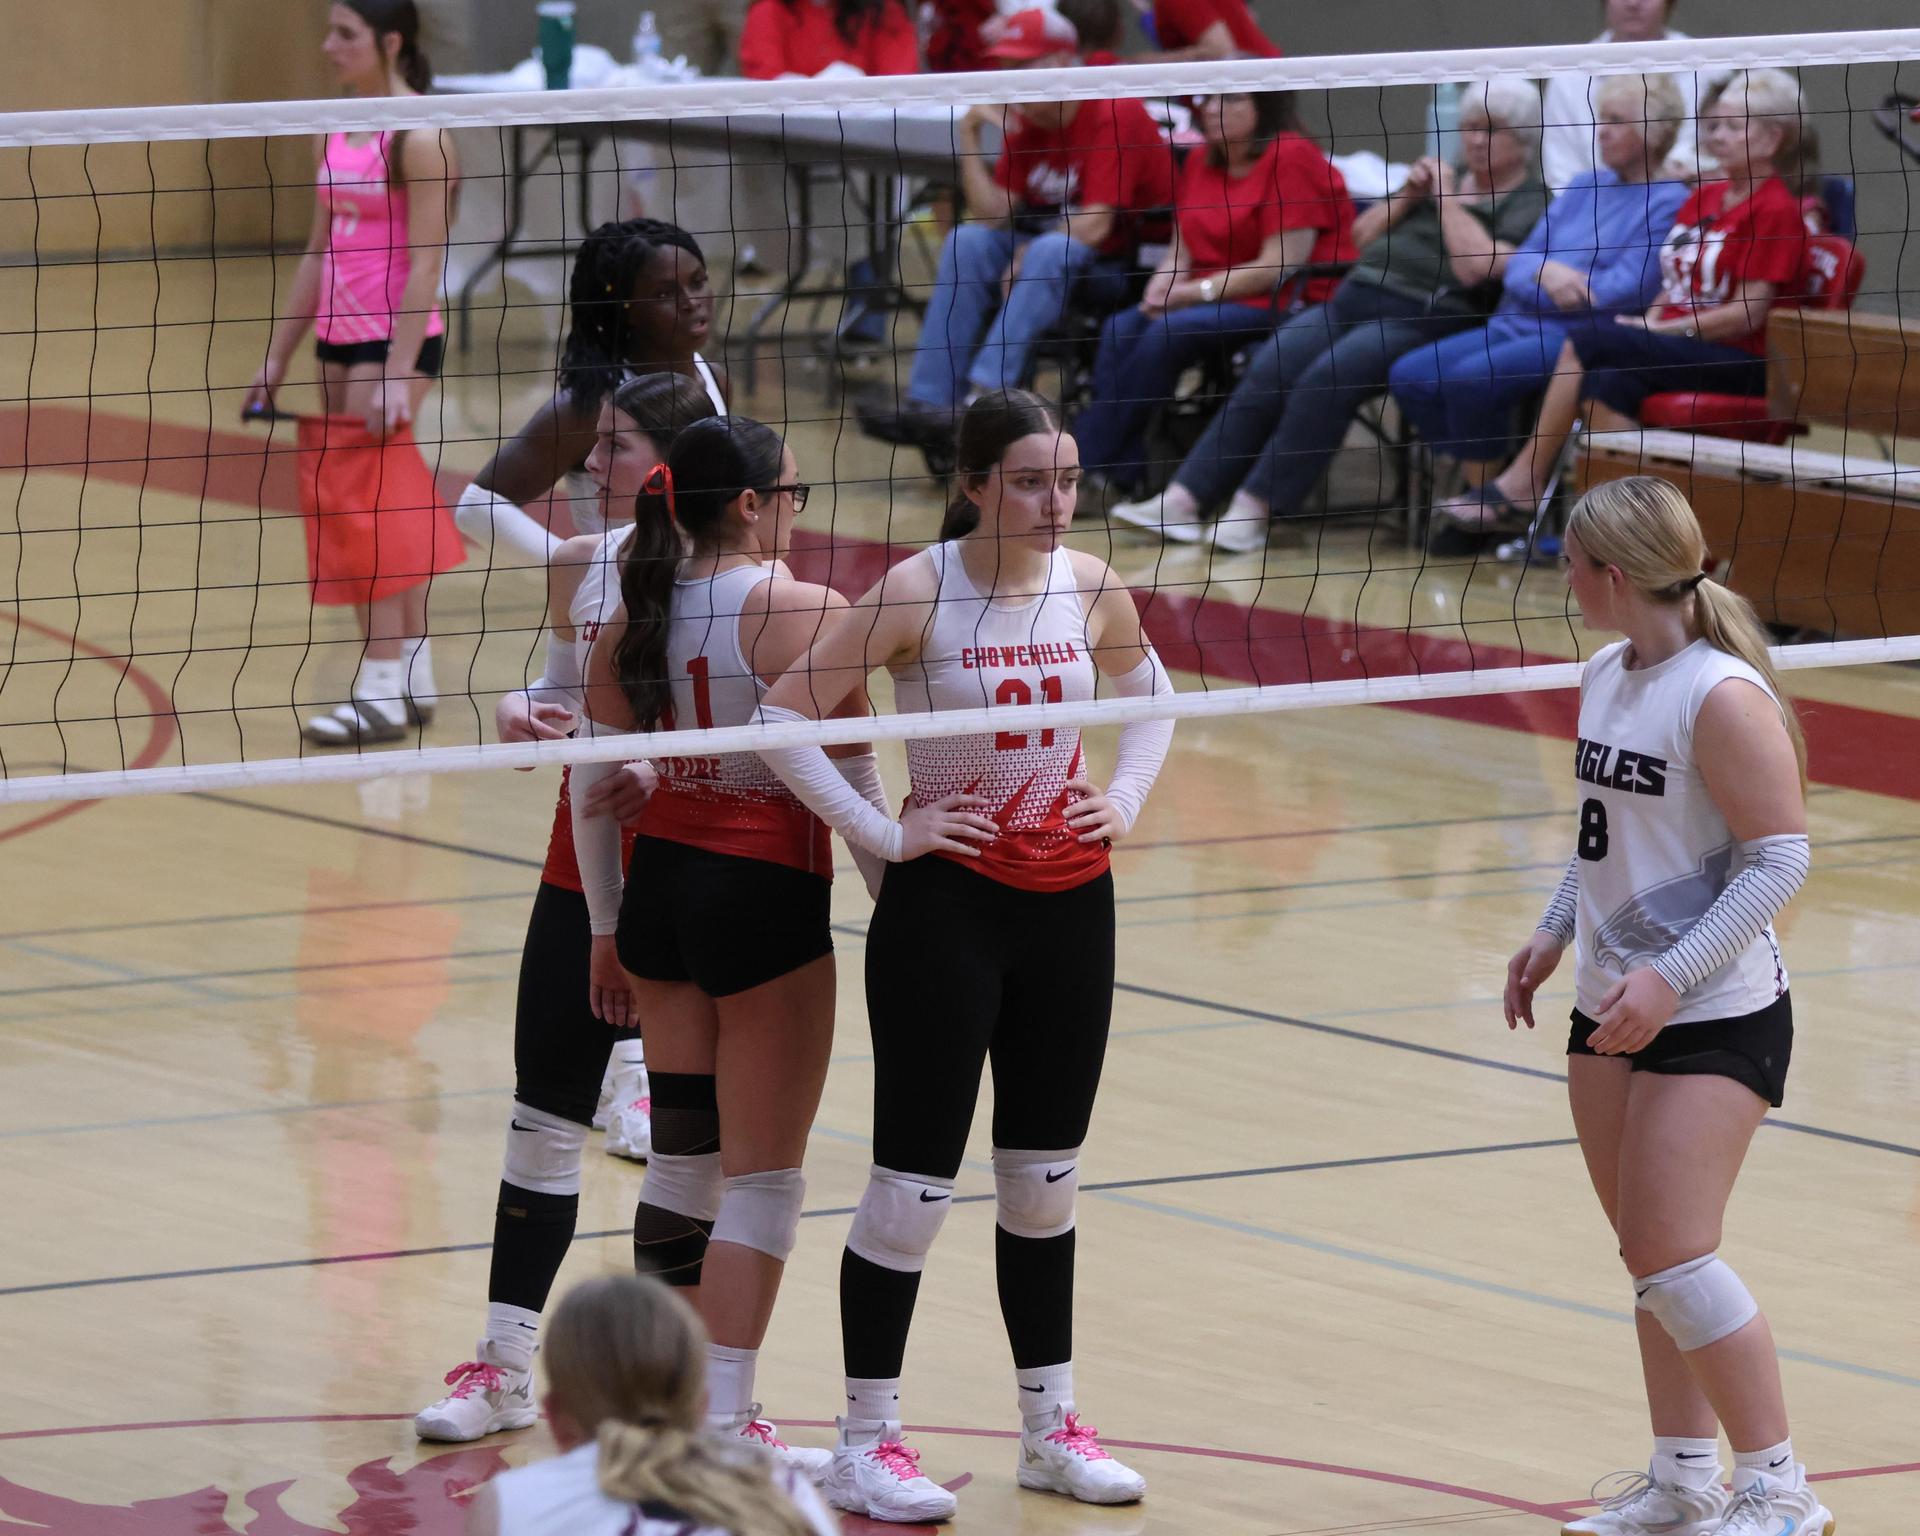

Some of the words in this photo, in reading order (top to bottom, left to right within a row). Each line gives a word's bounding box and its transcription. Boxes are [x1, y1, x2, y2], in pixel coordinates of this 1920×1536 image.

[962, 642, 1079, 669] CHOWCHILLA
[995, 675, 1063, 751] 21
[1578, 798, 1609, 862] 8
